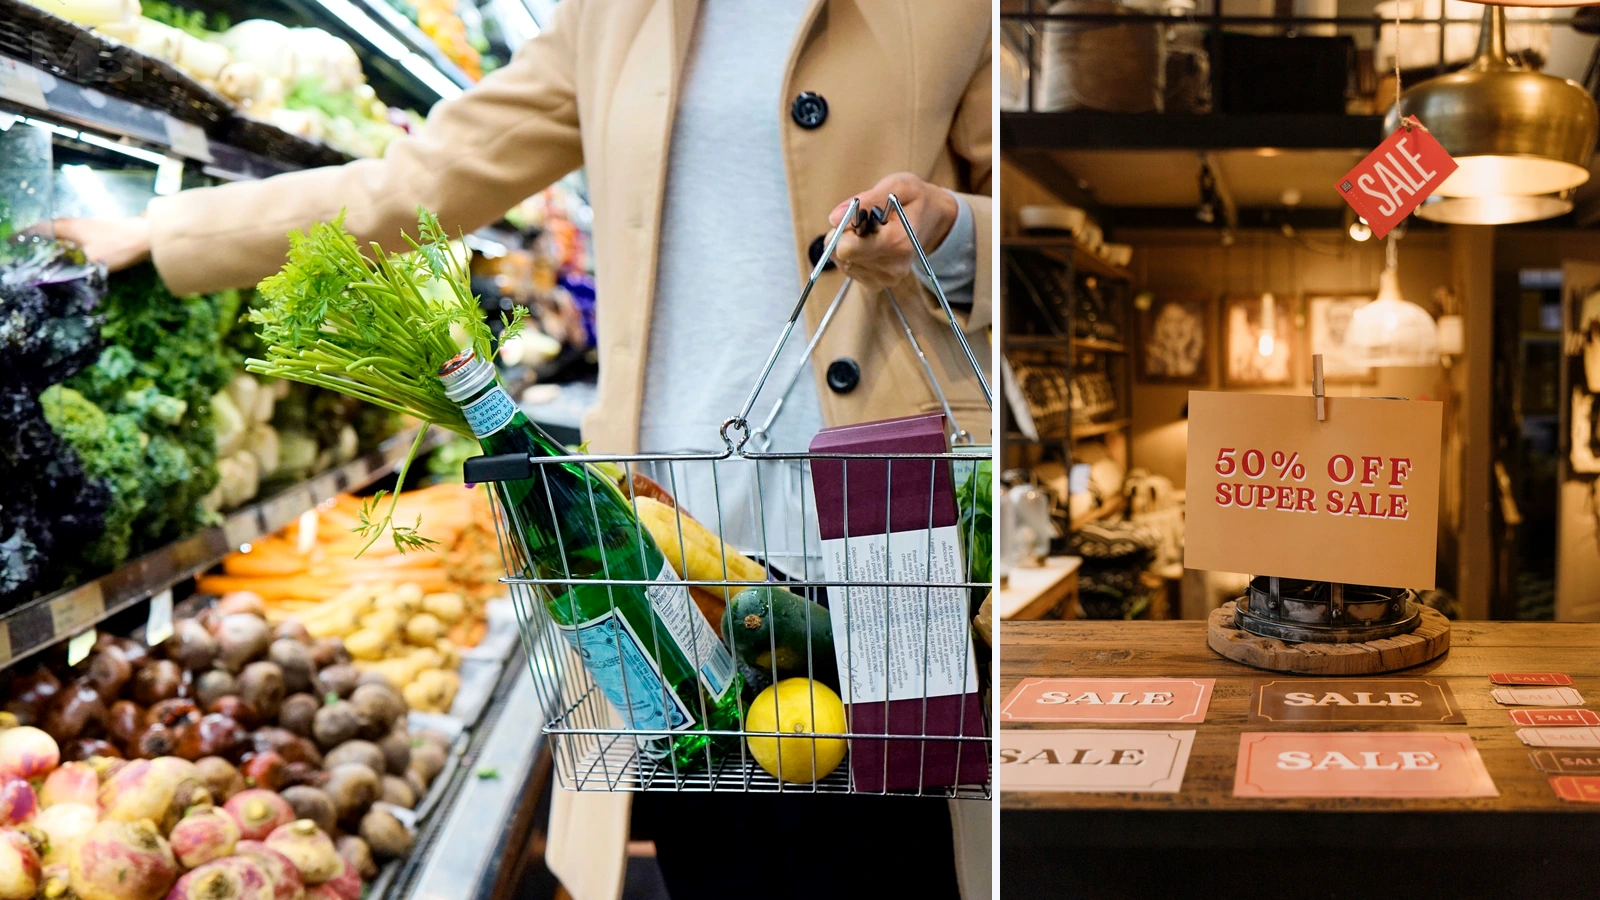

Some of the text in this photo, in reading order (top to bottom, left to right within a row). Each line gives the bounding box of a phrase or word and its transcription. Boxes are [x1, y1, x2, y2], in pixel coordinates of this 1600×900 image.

[1357, 137, 1437, 217] SALE
[1215, 448, 1413, 489] 50% OFF
[1215, 482, 1410, 521] SUPER SALE
[870, 562, 878, 580] produit
[912, 564, 920, 581] unique
[907, 602, 912, 611] We
[947, 551, 955, 568] Lesley
[958, 633, 966, 651] making
[858, 606, 867, 631] craquelins
[912, 604, 920, 621] topped
[856, 630, 864, 651] fromage
[873, 627, 881, 644] Lesley
[891, 628, 899, 653] craquelins
[945, 666, 953, 684] product
[1036, 691, 1174, 706] SALE
[1284, 692, 1423, 707] SALE
[1000, 748, 1147, 766] SALE
[1276, 751, 1442, 771] SALE
